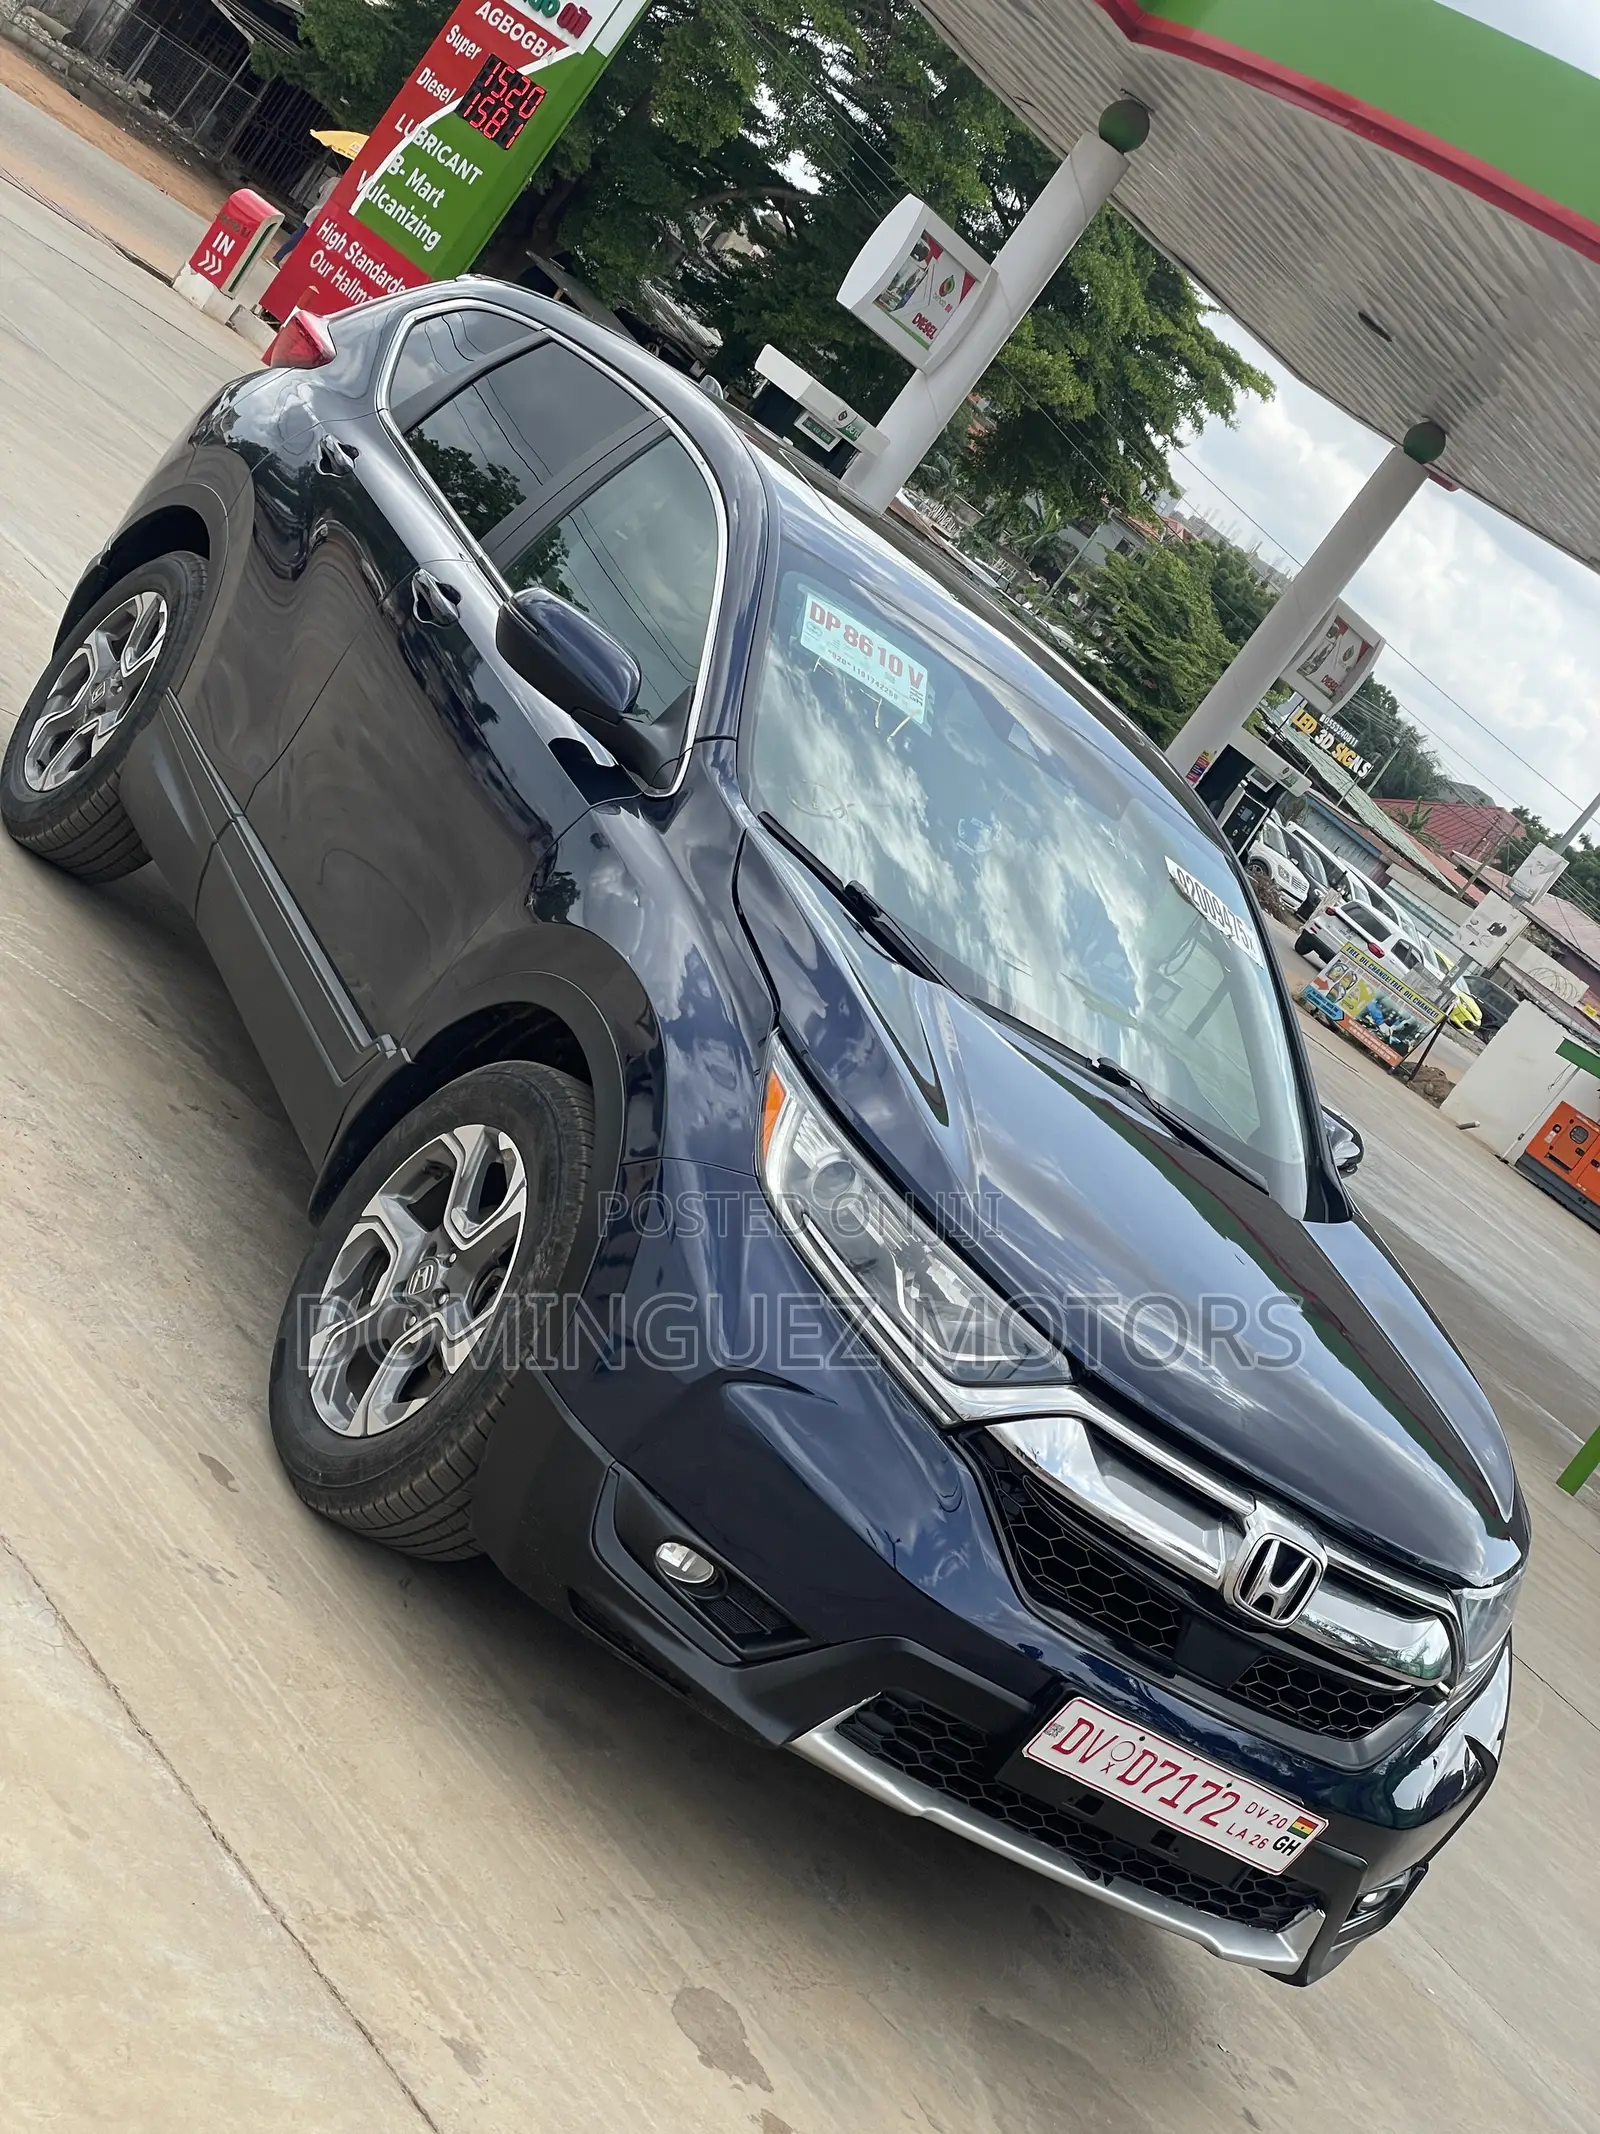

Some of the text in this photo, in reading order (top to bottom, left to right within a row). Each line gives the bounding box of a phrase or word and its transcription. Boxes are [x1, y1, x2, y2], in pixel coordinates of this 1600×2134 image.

[445, 24, 482, 60] Super
[475, 1, 557, 63] AGBOGBA
[416, 67, 456, 104] Diesel
[394, 113, 483, 186] LUBRICANT
[356, 170, 441, 252] Vulcanizing
[405, 168, 445, 208] Mart
[212, 230, 235, 257] IN
[316, 218, 347, 253] High
[310, 249, 373, 304] Our Hallm
[809, 600, 841, 631] DP
[843, 624, 903, 677] 8610
[908, 664, 924, 690] V
[1292, 709, 1372, 777] LED 3D SIGNS
[1346, 946, 1360, 958] FREE
[1360, 956, 1369, 966] OIL
[1390, 980, 1404, 992] FREE
[1403, 991, 1413, 1001] OIL
[1051, 1717, 1241, 1828] DV D7172
[1225, 1822, 1269, 1849] LA 26
[1245, 1802, 1288, 1828] DV 20
[1272, 1836, 1301, 1856] GH
